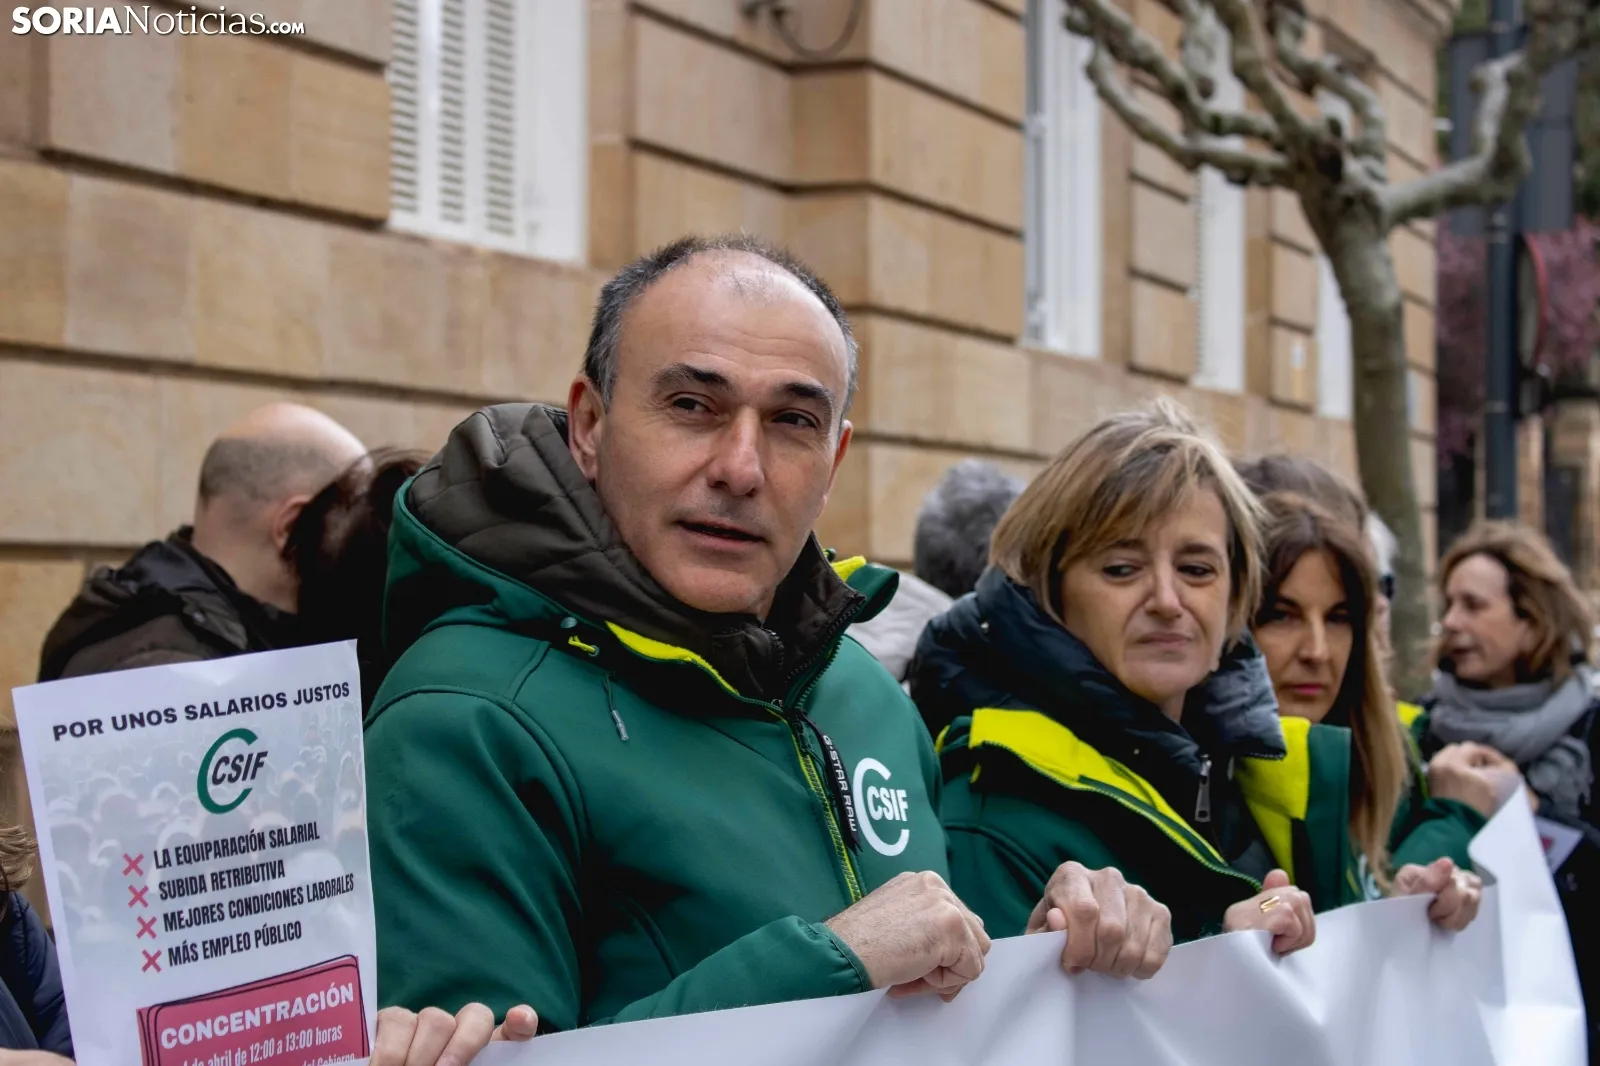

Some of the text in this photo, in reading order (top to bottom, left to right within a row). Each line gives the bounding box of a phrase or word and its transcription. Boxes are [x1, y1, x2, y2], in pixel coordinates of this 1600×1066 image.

[52, 682, 350, 742] POR UNOS SALARIOS JUSTOS
[211, 751, 268, 785] CSIF
[843, 794, 858, 832] RAW
[867, 785, 909, 821] CSIF
[154, 821, 320, 869] LA EQUIPARACIÓN SALARIAL
[158, 859, 286, 901] SUBIDA RETRIBUTIVA
[163, 872, 355, 932] MEJORES CONDICIONES LABORALES
[168, 920, 302, 967] MÁS EMPLEO PÚBLICO
[161, 982, 355, 1050] CONCENTRACIÓN
[235, 1047, 247, 1066] de
[249, 1038, 275, 1063] 12:00
[277, 1040, 283, 1055] a
[285, 1028, 313, 1053] 13:00
[315, 1024, 343, 1046] horas
